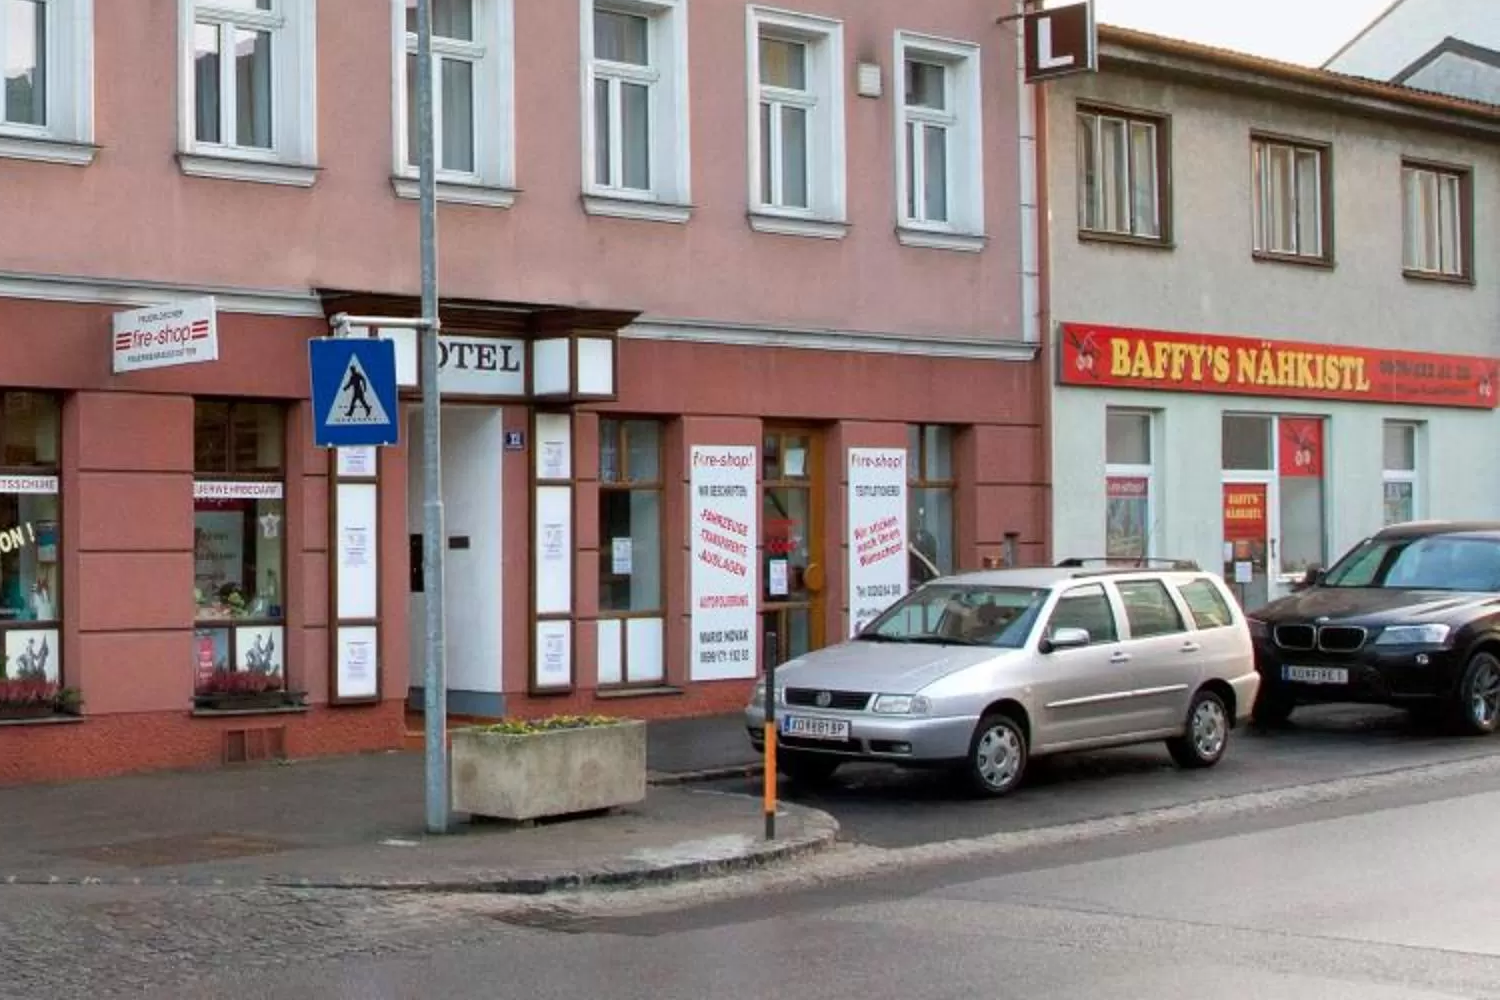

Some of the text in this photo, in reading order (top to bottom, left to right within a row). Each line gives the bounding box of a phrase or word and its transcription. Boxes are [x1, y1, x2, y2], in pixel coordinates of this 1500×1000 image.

[133, 324, 191, 347] fire-shop
[1110, 337, 1230, 383] BAFFY'S
[1237, 341, 1371, 392] NÄHKISTL
